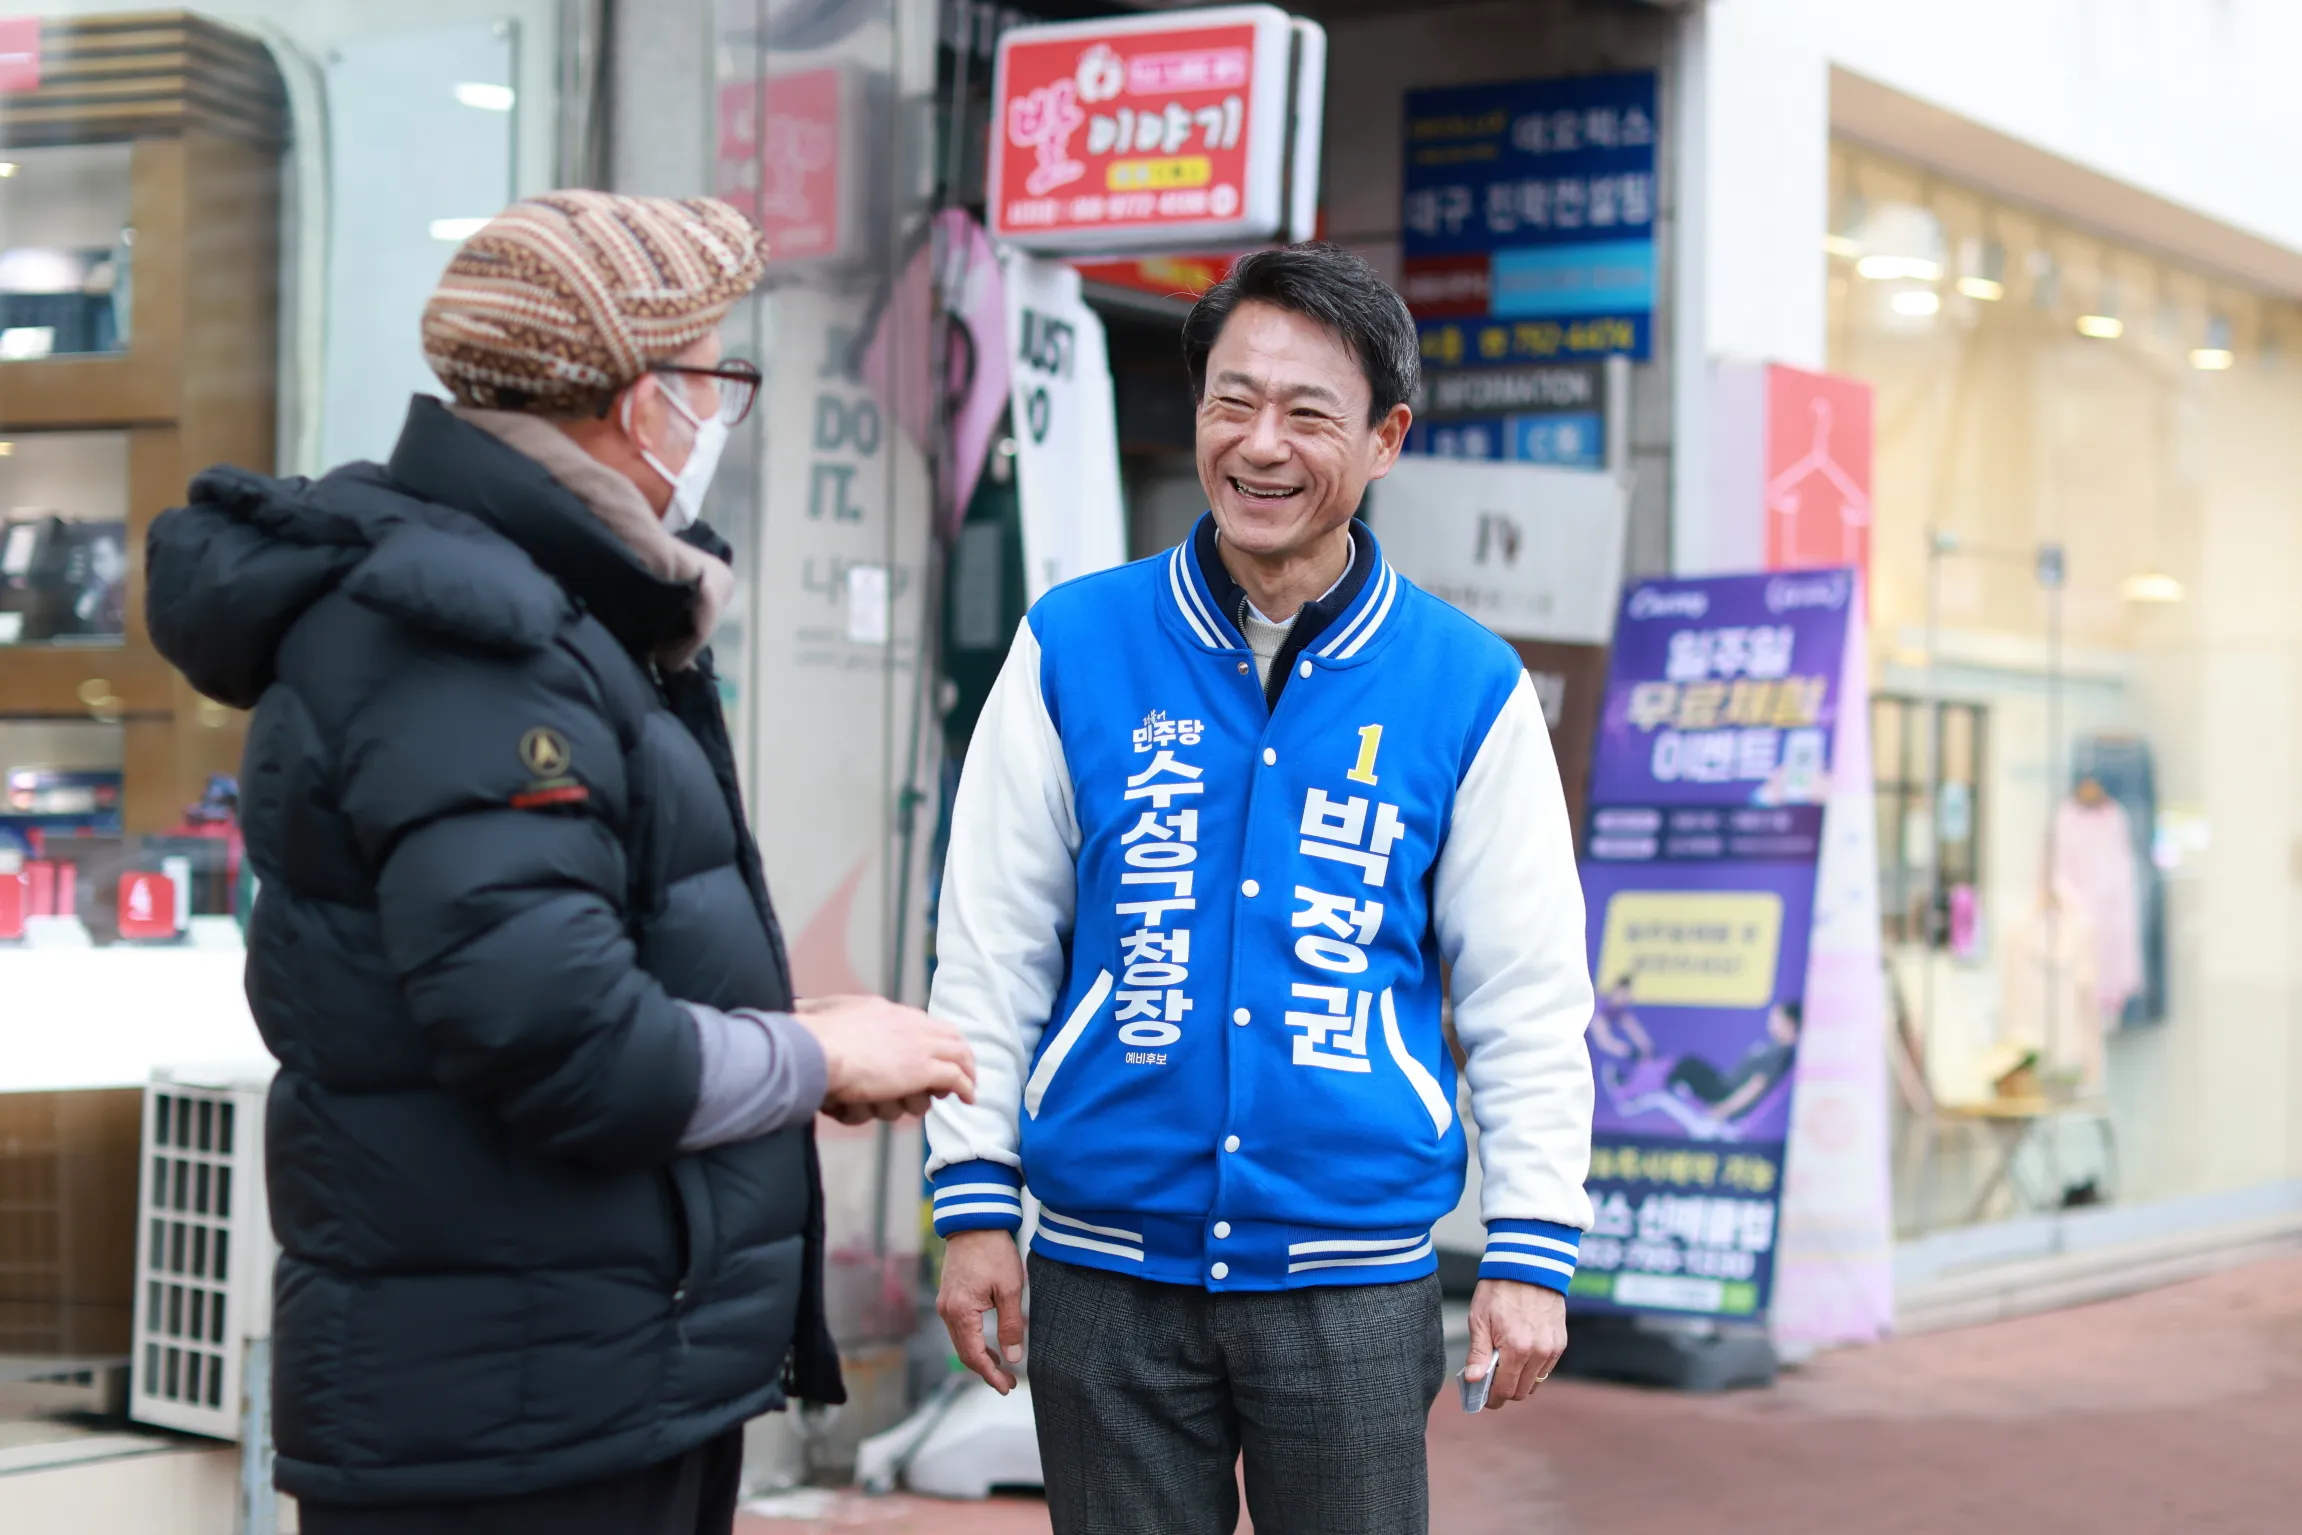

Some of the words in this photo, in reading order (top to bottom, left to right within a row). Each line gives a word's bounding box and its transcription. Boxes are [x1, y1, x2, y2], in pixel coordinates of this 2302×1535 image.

[1132, 719, 1205, 753] 민주당
[1346, 723, 1383, 787] 1
[1114, 750, 1204, 1047] 수성구청장
[1284, 787, 1405, 1073] 박정권
[1125, 1050, 1168, 1066] 예비후보
